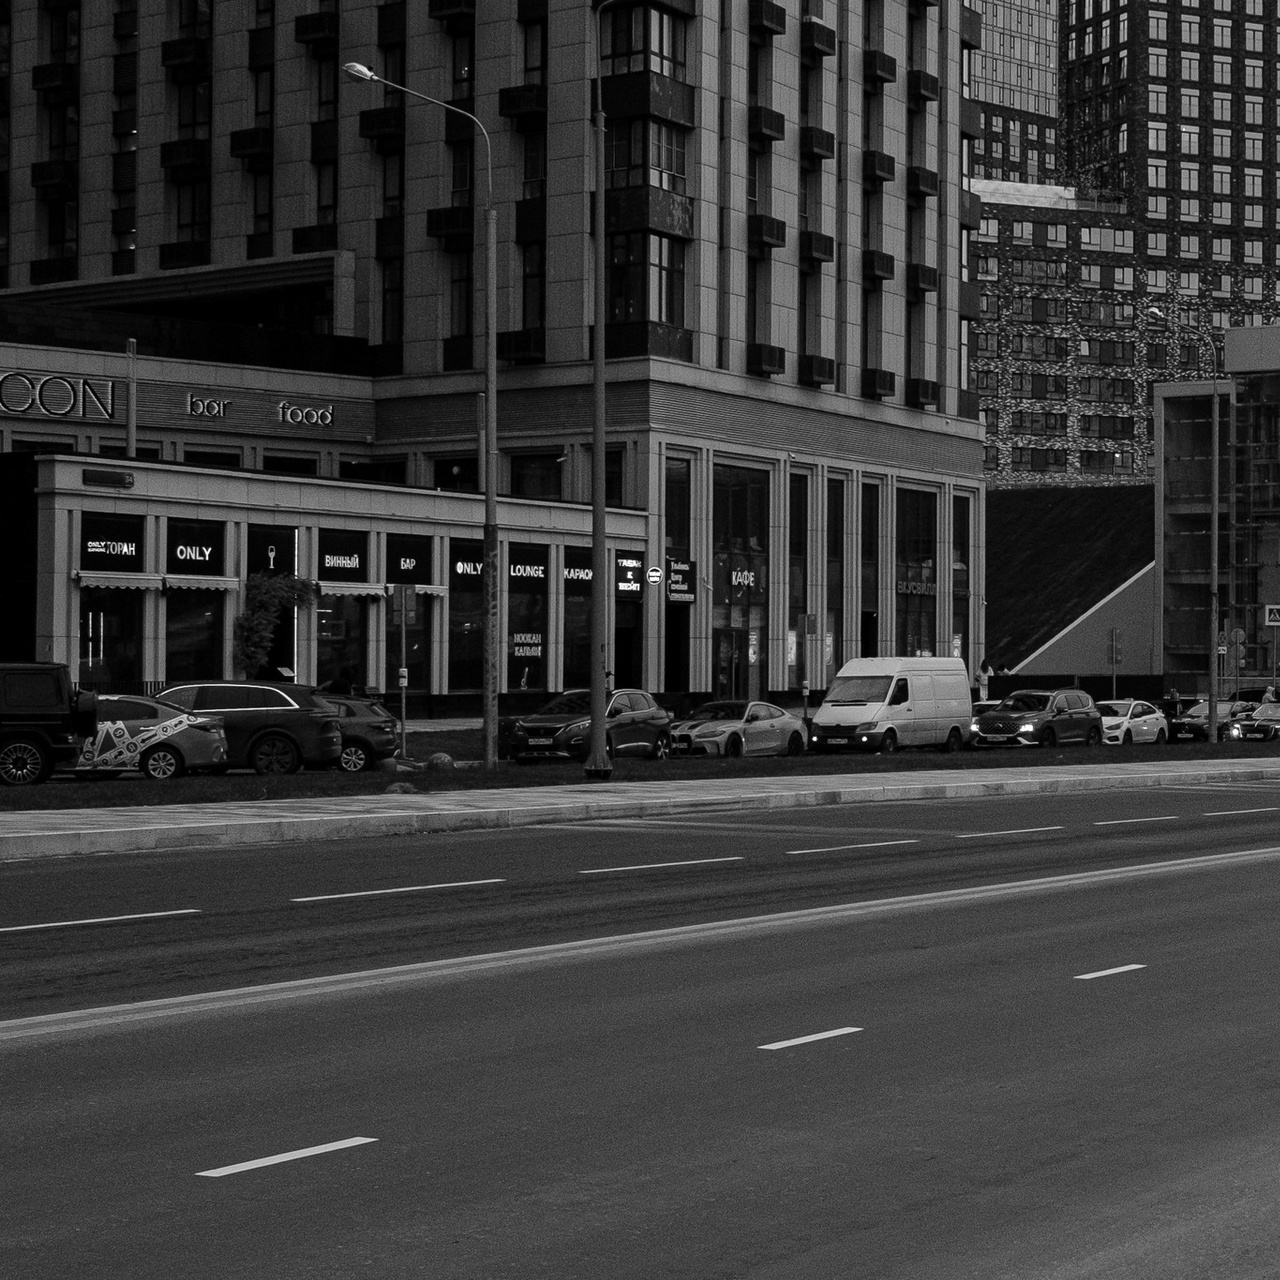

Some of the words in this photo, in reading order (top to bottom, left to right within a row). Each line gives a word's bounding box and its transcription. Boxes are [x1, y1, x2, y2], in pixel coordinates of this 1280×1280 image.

[188, 393, 232, 418] bar
[279, 400, 335, 427] food
[176, 545, 212, 561] ONLY
[325, 554, 359, 568] ВИННЫЙ
[400, 557, 416, 570] БАР
[456, 561, 484, 575] ONLY
[510, 564, 545, 578] LOUNGE
[732, 569, 755, 586] КАФЕ
[513, 633, 542, 644] HOOKAH
